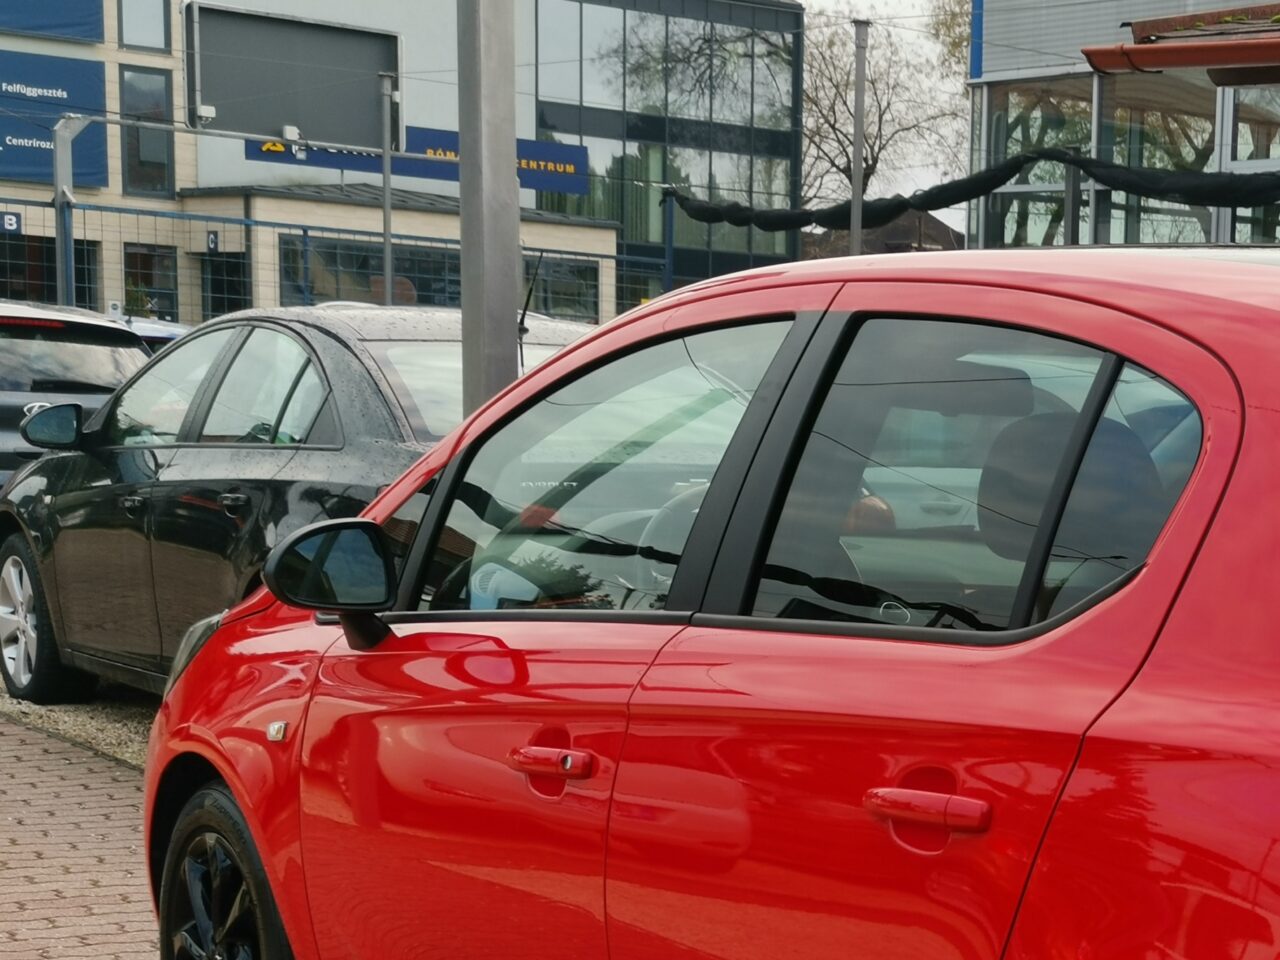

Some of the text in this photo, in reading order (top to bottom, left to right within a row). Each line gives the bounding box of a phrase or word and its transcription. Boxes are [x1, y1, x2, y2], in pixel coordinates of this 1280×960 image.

[2, 82, 69, 99] Felfüggesztés
[426, 147, 576, 174] RÓM ENTRUM
[4, 214, 17, 230] B
